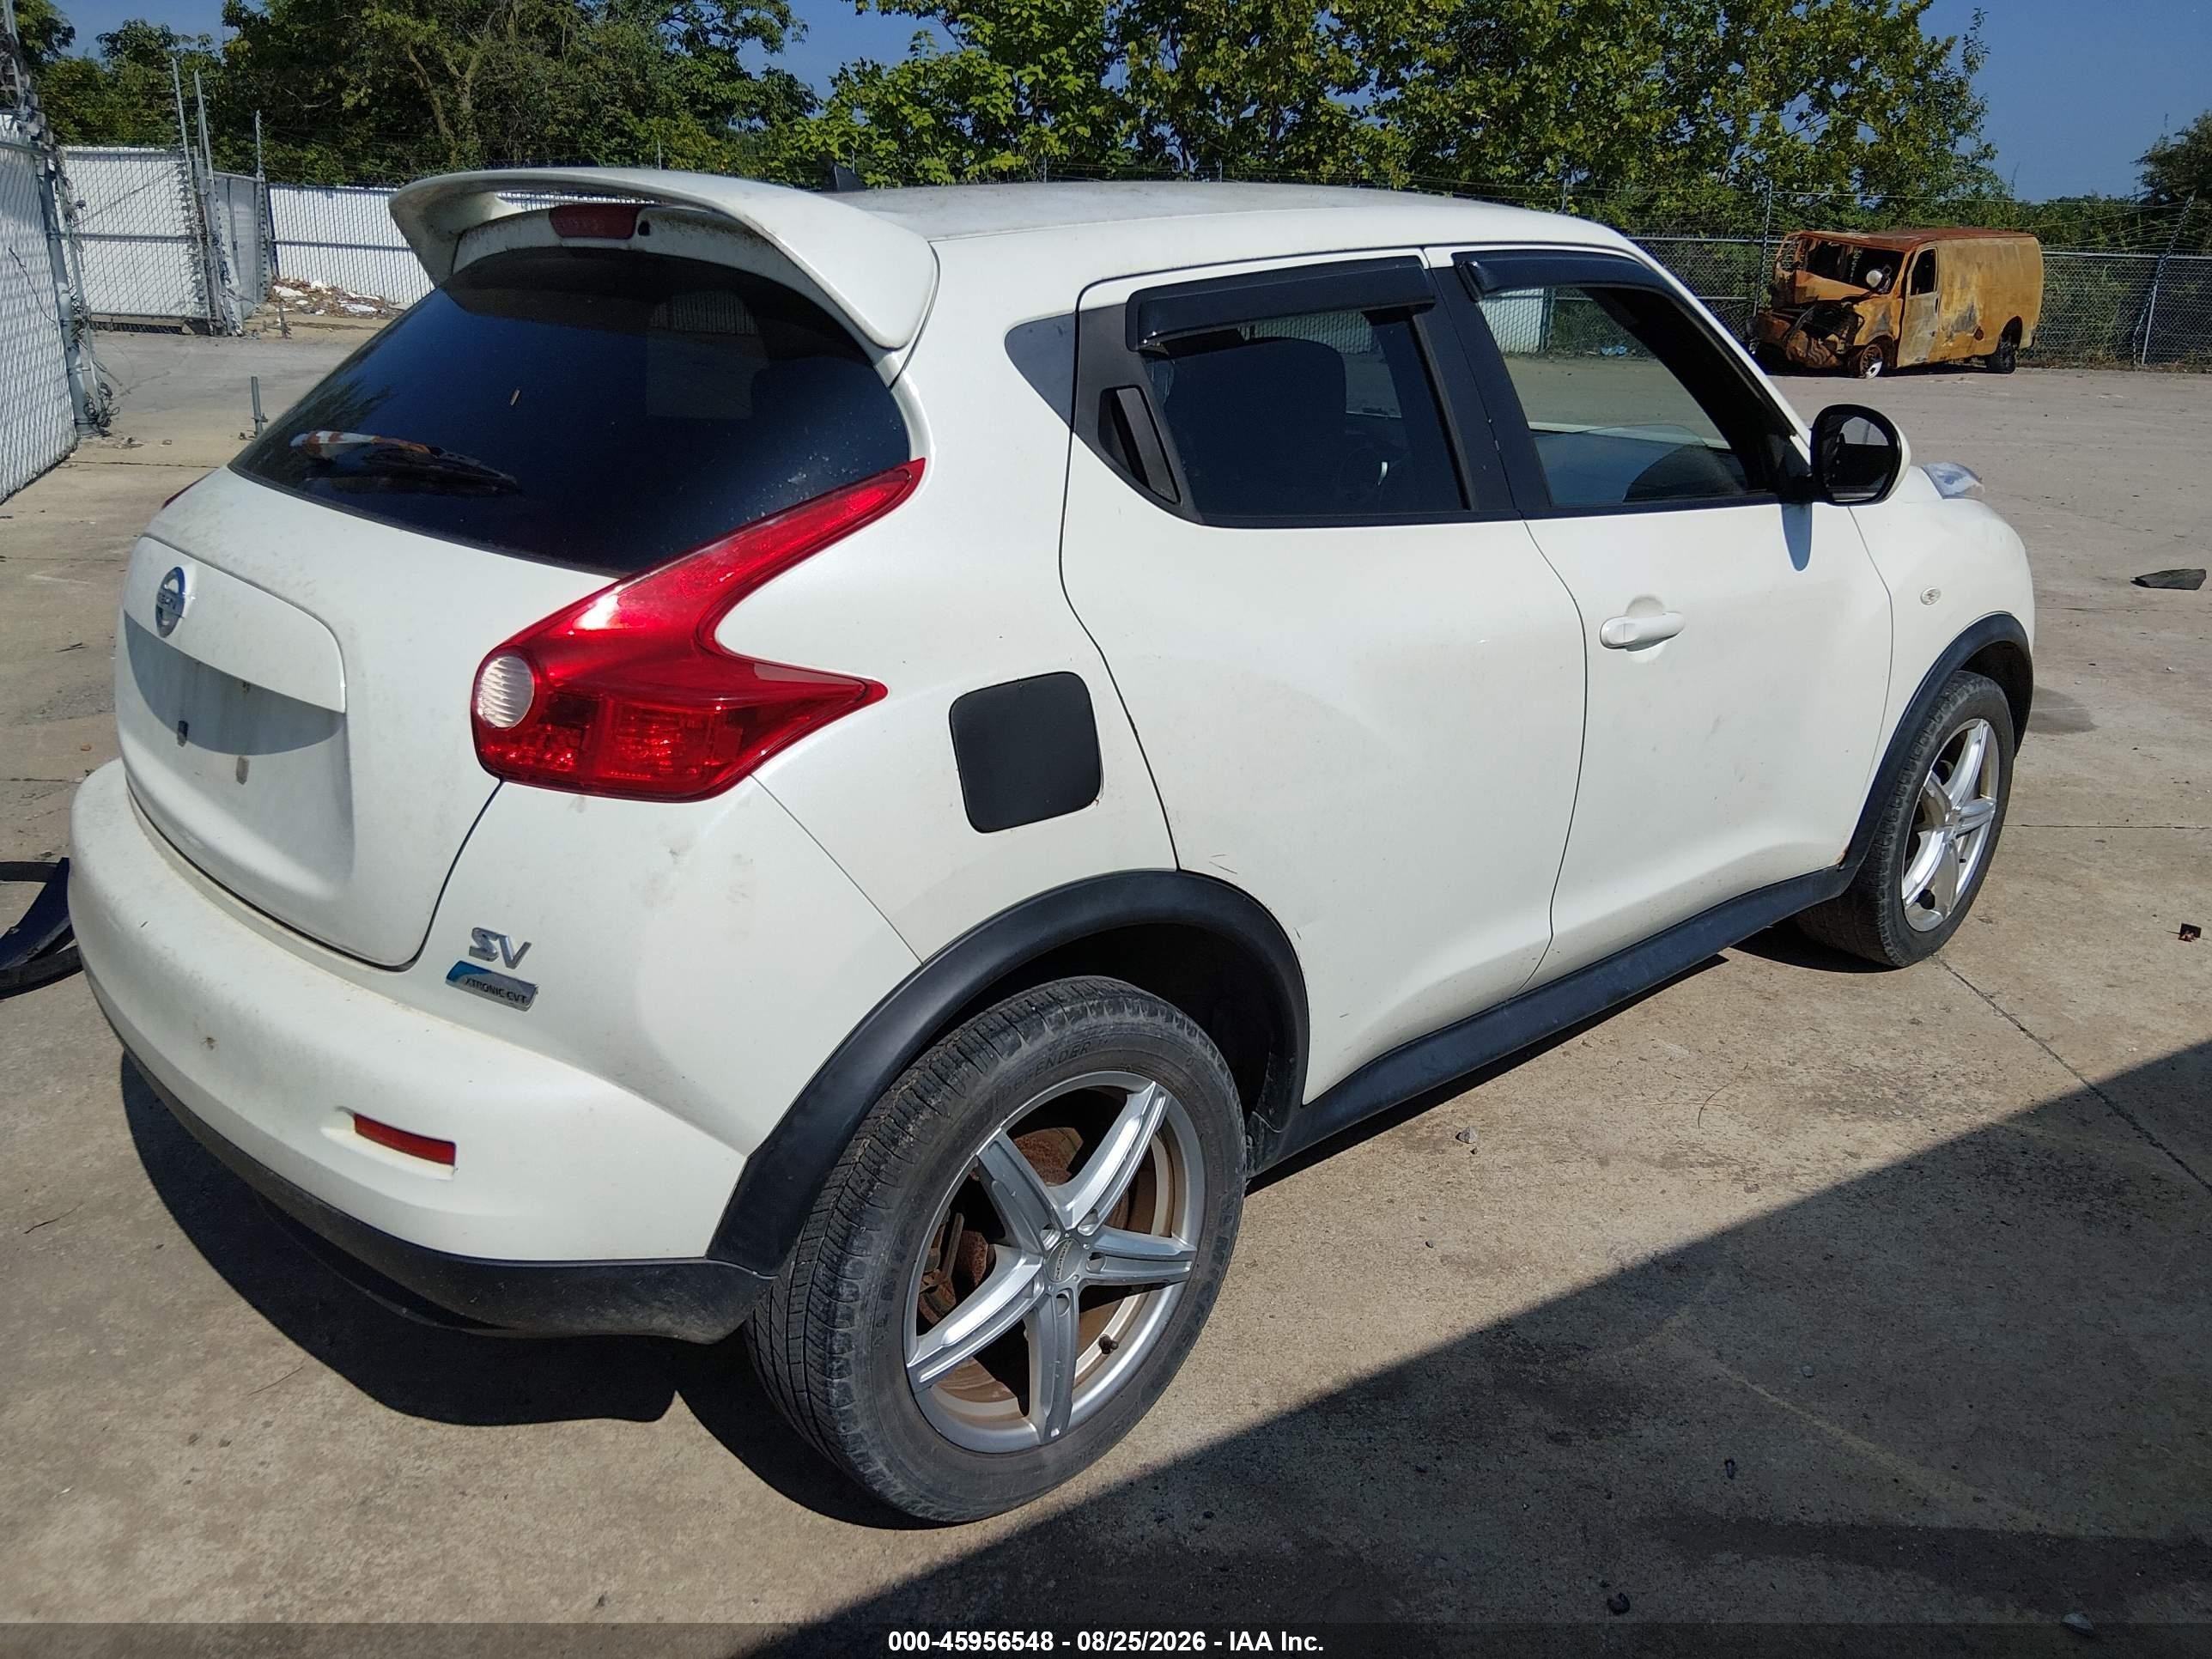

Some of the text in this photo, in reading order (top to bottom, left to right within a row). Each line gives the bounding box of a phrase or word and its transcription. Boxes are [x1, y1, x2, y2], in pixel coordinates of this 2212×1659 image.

[469, 927, 532, 970] SV
[465, 976, 528, 1004] XTRONIC CVT
[1001, 1040, 1092, 1102] DEFENDER
